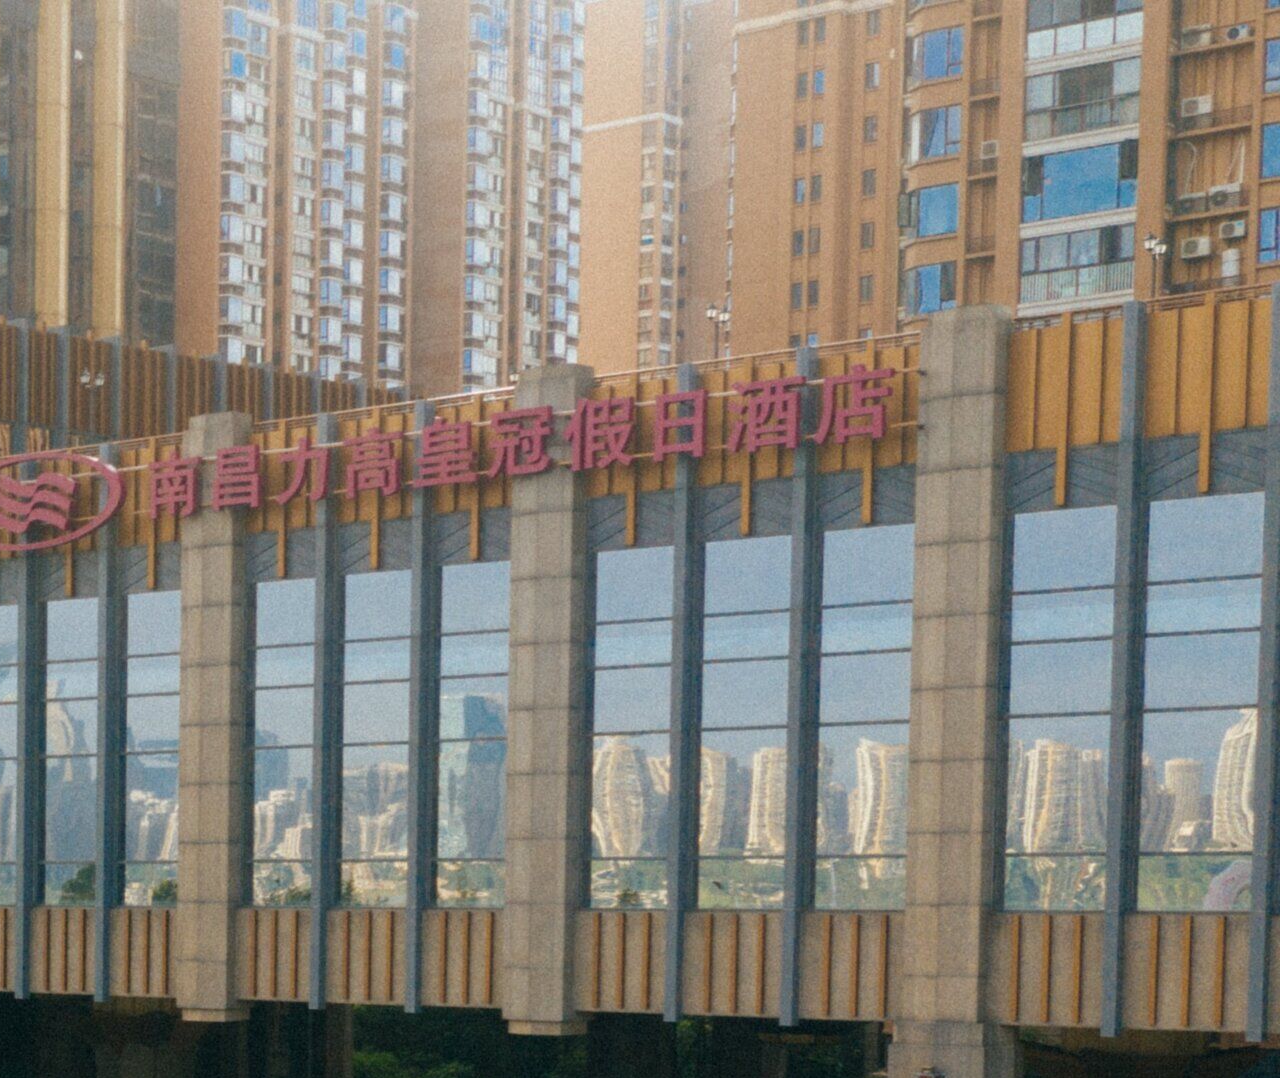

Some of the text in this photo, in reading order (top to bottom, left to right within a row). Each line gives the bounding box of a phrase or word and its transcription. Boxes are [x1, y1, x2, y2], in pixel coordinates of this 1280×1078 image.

[148, 364, 895, 519] 南昌力高皇冠假日酒店
